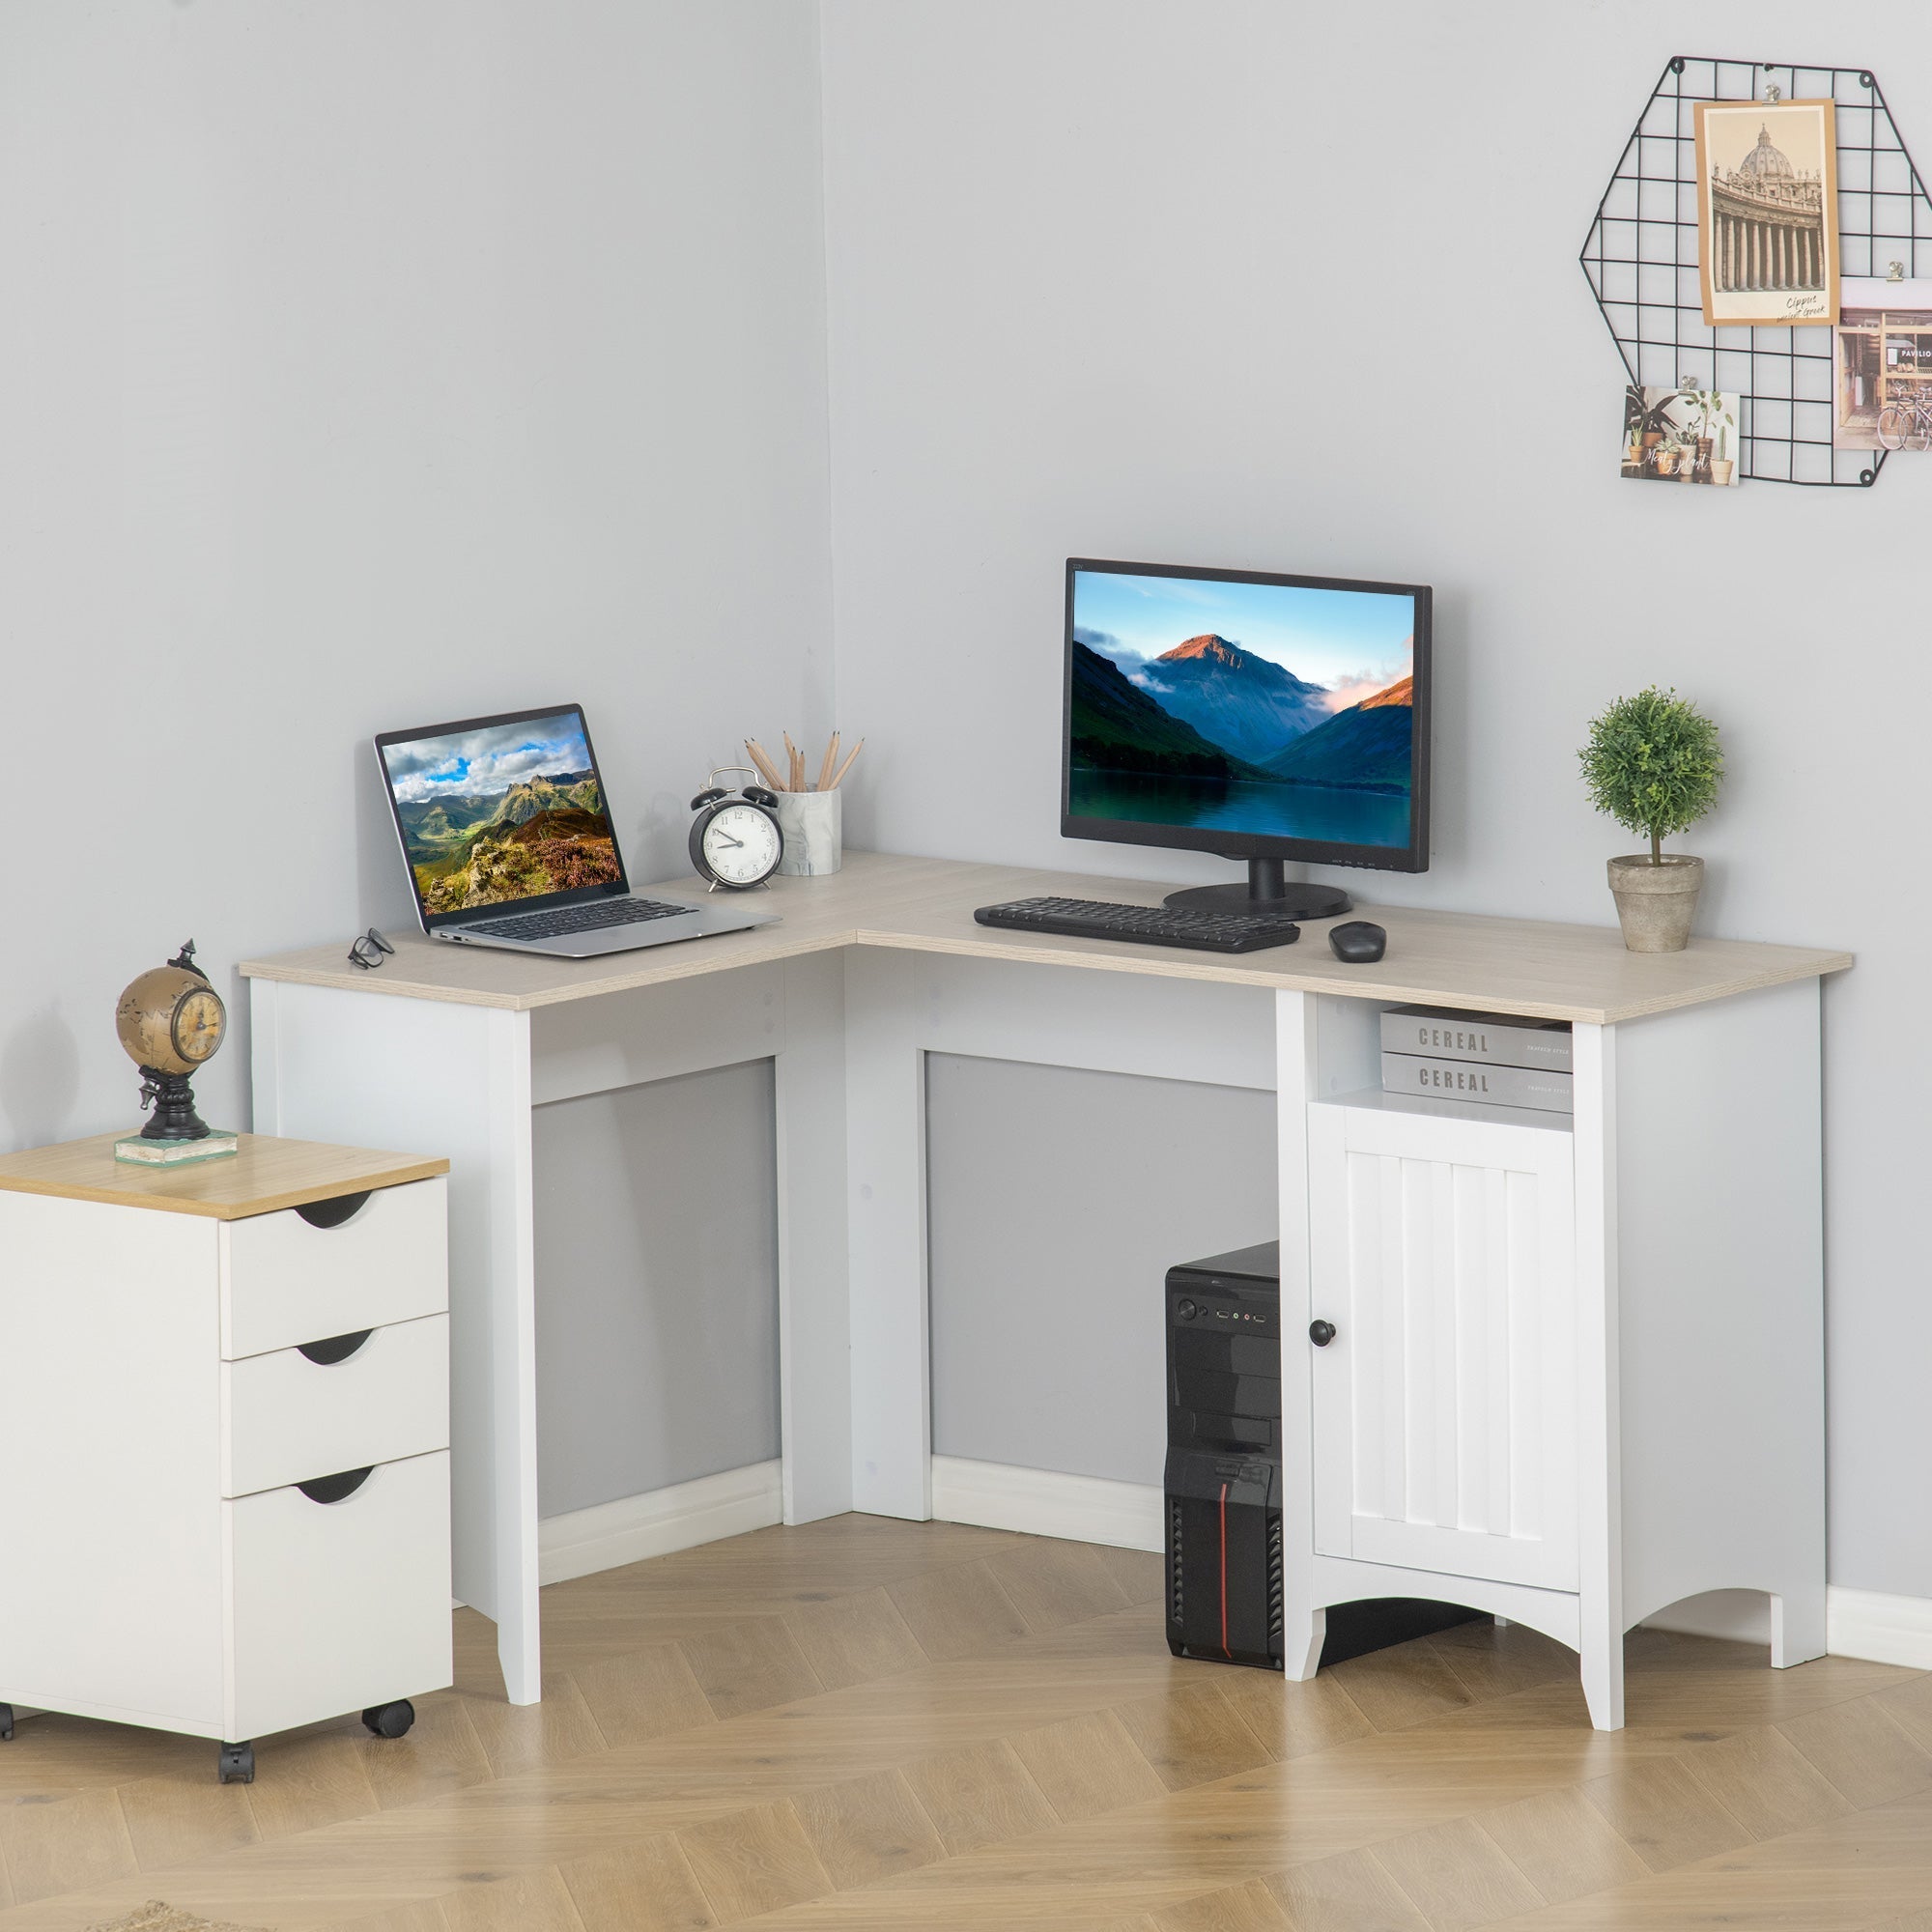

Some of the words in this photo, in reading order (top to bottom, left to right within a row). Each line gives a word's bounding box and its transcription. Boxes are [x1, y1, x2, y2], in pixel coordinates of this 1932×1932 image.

[721, 816, 728, 825] 11
[760, 824, 767, 833] 2
[706, 841, 713, 850] 9
[766, 838, 772, 847] 3
[712, 855, 719, 864] 8
[724, 865, 730, 873] 7
[737, 868, 744, 877] 6
[1418, 1027, 1489, 1052] CEREAL
[1419, 1067, 1489, 1093] CEREAL
